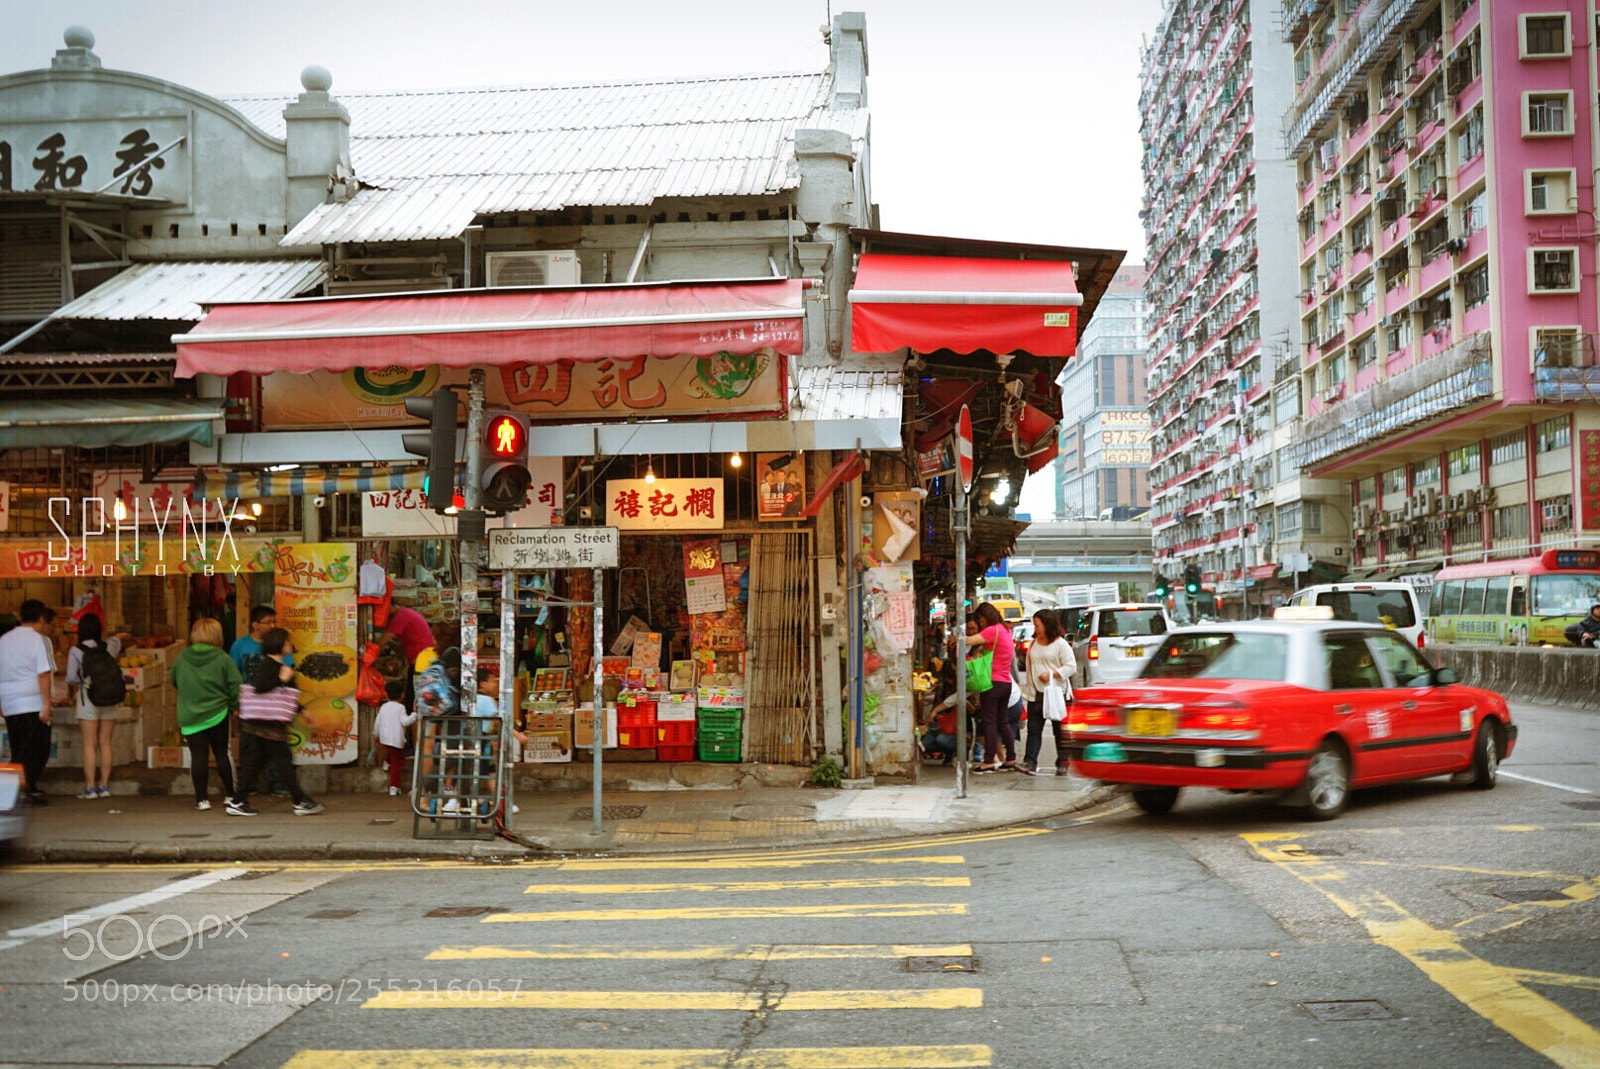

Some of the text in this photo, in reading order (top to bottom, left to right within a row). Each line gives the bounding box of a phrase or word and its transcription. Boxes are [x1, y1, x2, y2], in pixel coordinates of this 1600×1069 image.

[613, 486, 716, 519] 禧記欄
[495, 533, 611, 545] Reclamation Street
